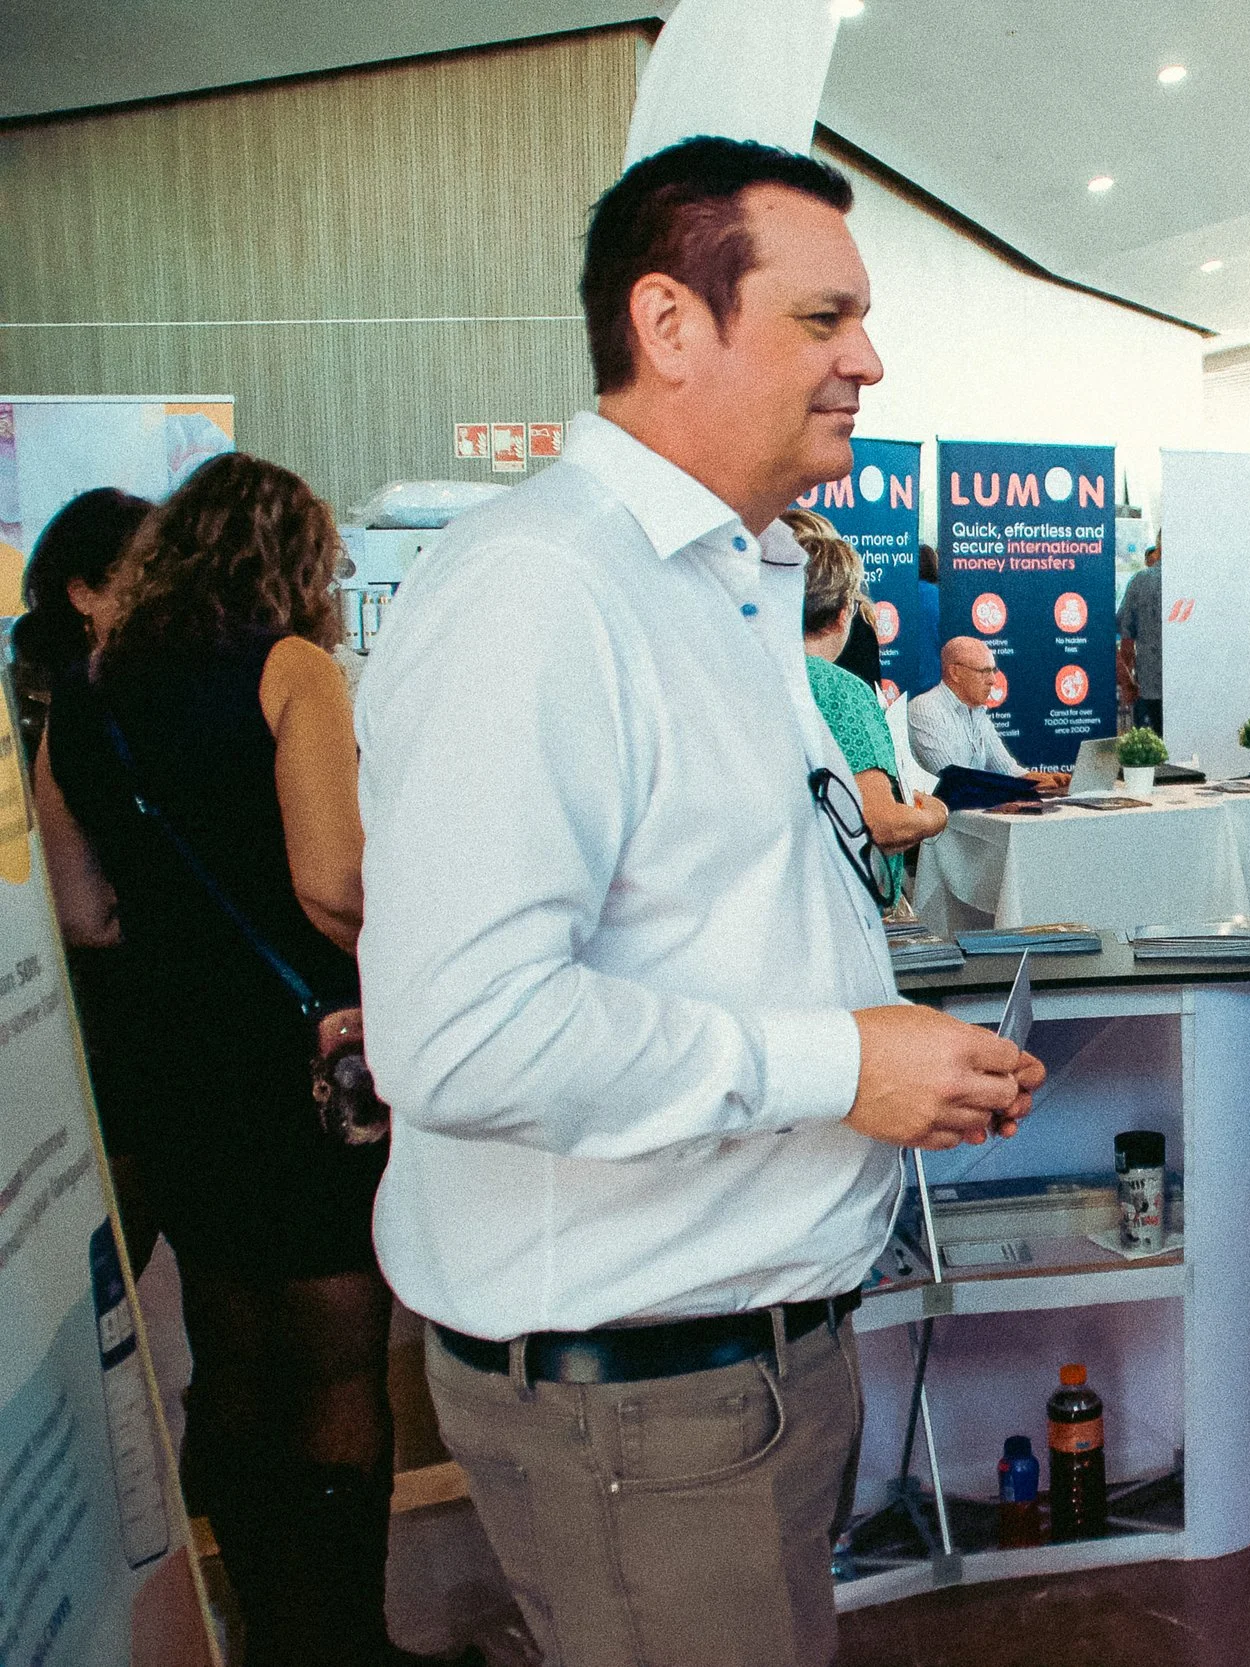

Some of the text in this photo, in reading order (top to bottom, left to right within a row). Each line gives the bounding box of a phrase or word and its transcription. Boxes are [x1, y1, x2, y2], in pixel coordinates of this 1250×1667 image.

[796, 465, 913, 509] UMON
[951, 466, 1105, 509] LUMON
[952, 522, 1105, 539] Quick, effortless and
[861, 534, 893, 546] more
[896, 532, 909, 546] of
[952, 539, 1102, 554] secure international
[892, 552, 914, 567] you
[953, 555, 1075, 572] money transfers
[864, 567, 883, 582] as?
[1055, 637, 1087, 645] No hidden
